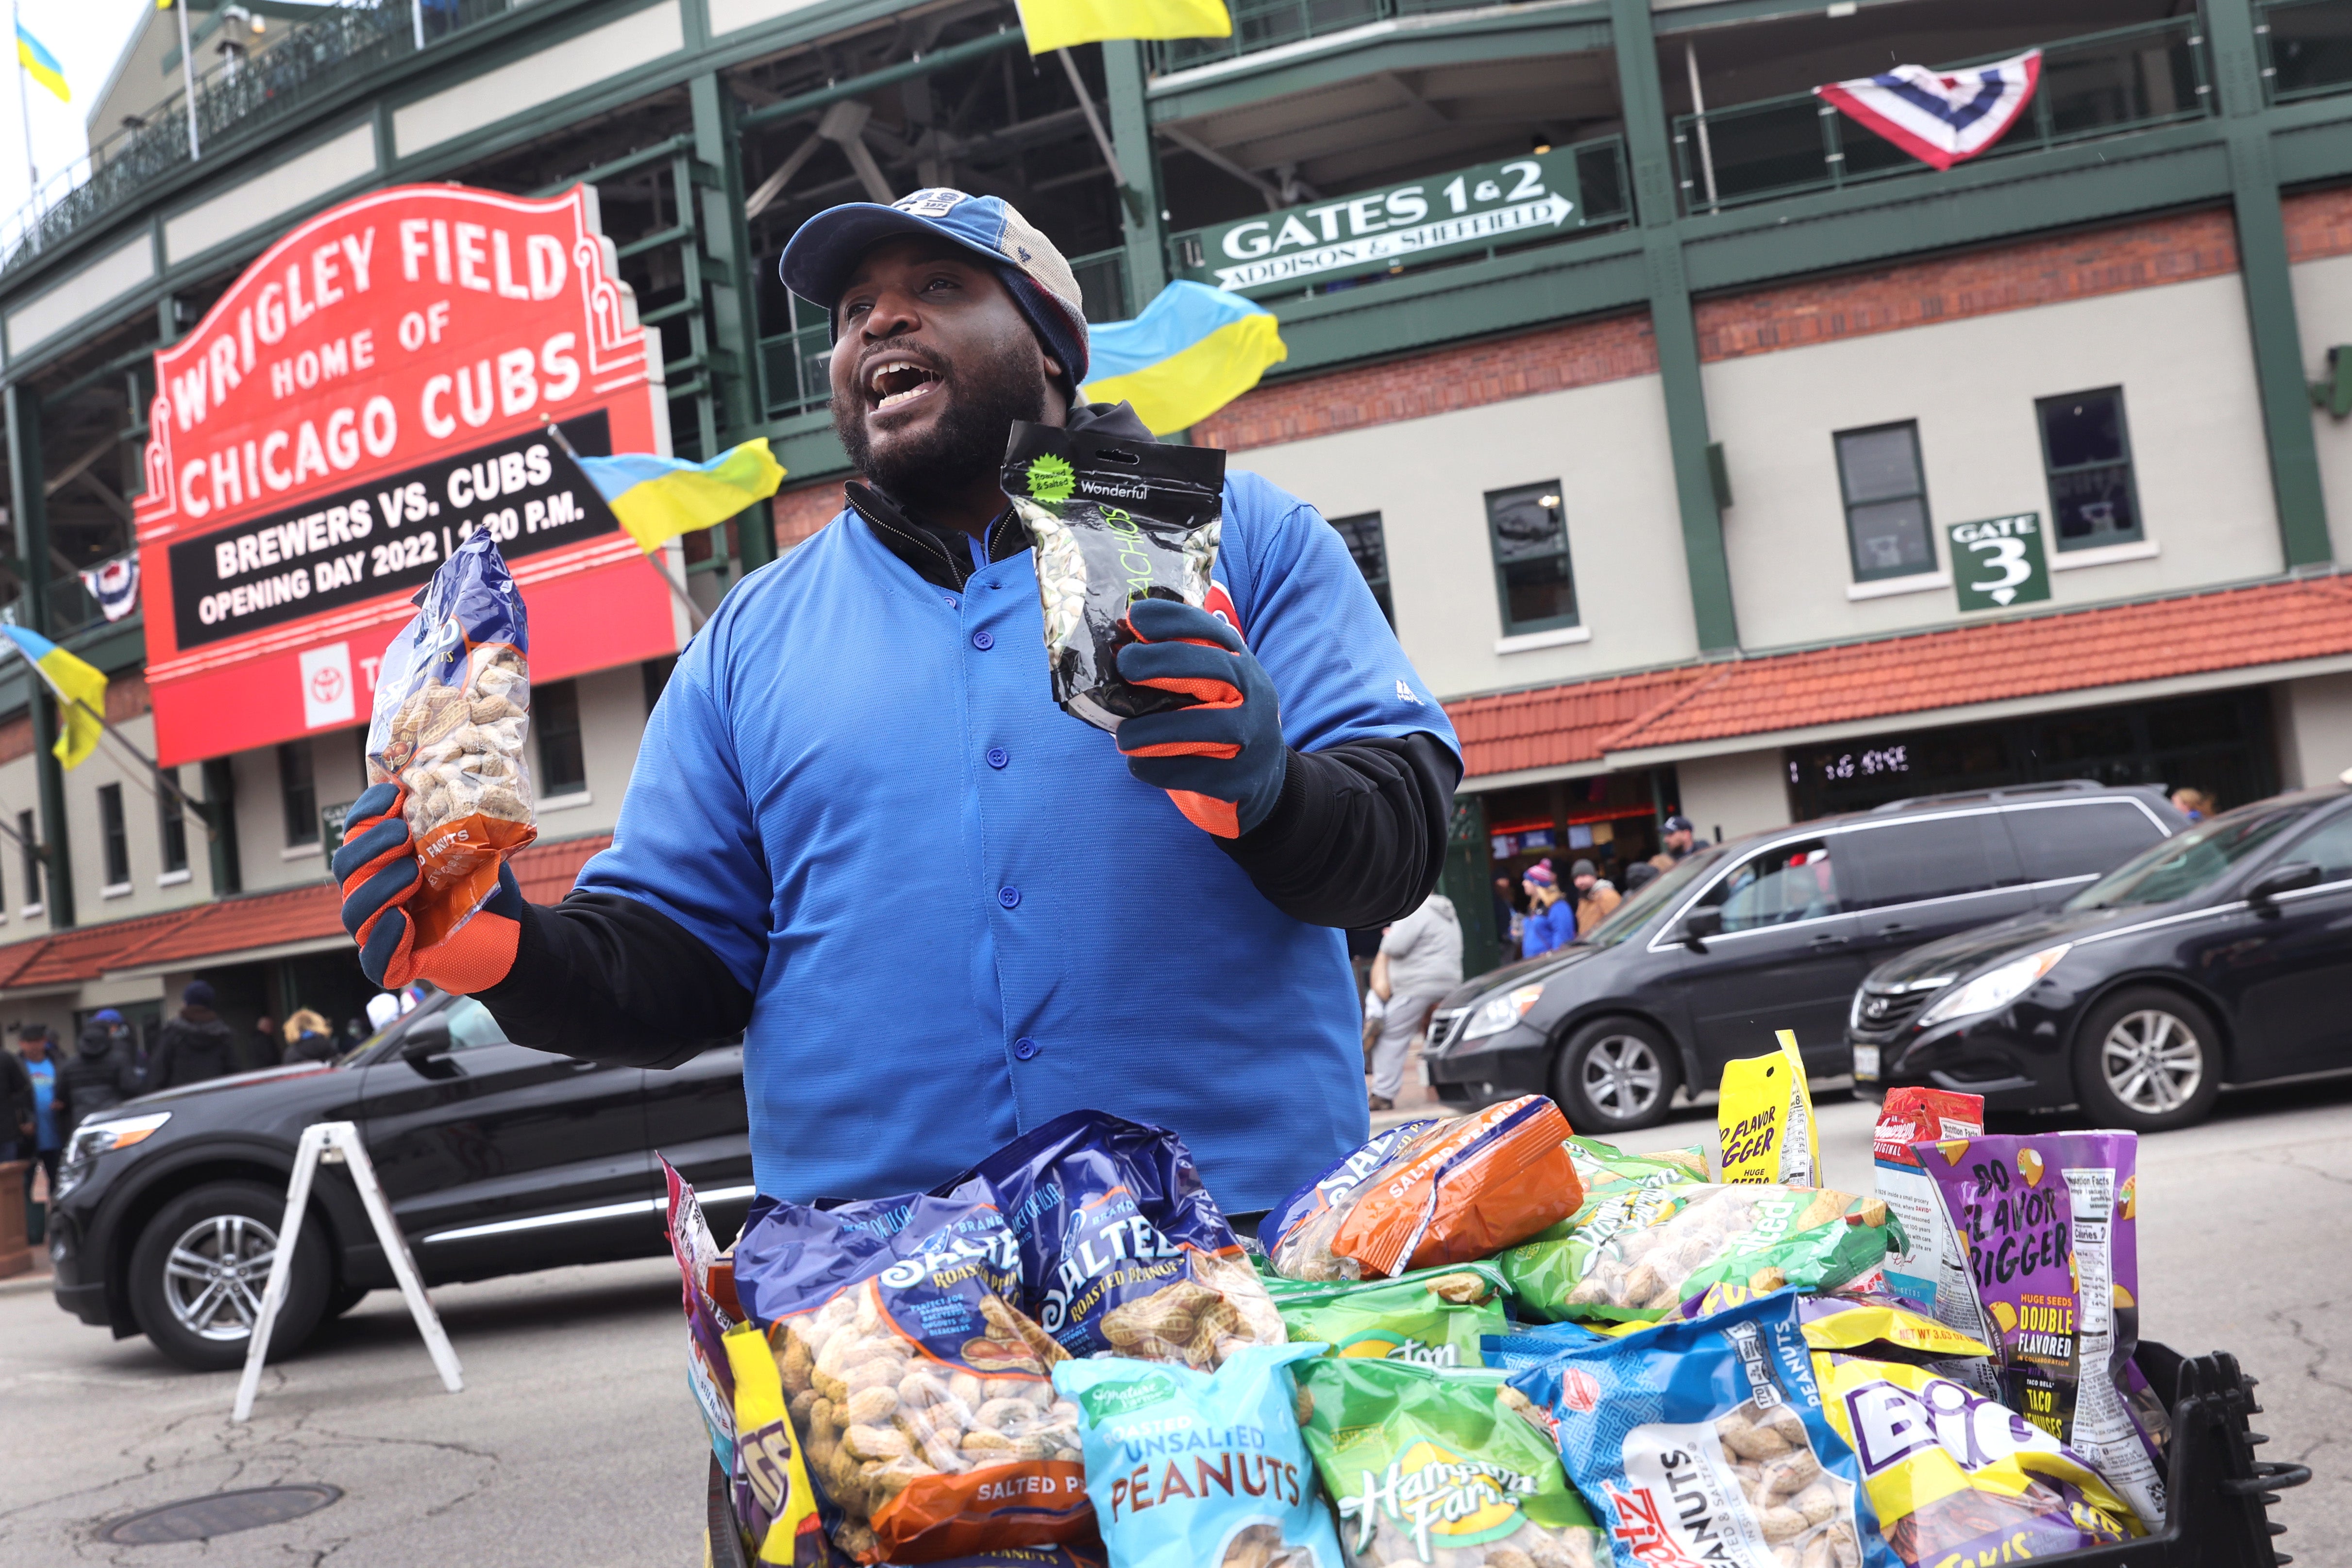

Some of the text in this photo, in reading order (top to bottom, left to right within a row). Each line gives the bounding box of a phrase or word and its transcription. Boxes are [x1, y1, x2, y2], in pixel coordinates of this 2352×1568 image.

[1222, 186, 1429, 260] GATES
[1229, 244, 1358, 289] ADDISON
[1400, 202, 1553, 251] SHEFFIELD
[171, 218, 568, 432] WRIGLEY FIELD
[270, 300, 451, 399] HOME OF
[180, 331, 582, 518] CHICAGO CUBS
[1034, 469, 1066, 482] Roasted
[1036, 478, 1069, 491] & Salted
[1080, 480, 1148, 500] Wonderful
[215, 443, 553, 580] BREWERS VS. CUBS
[1951, 514, 2037, 543] GATE
[198, 570, 312, 625] OPENING
[316, 552, 368, 594] DAY
[371, 530, 438, 579] 2022
[524, 490, 585, 534] P.M.
[1968, 536, 2032, 592] 3
[1730, 1106, 1776, 1143] FLAVOR
[1722, 1127, 1775, 1168] GGER
[1389, 1146, 1455, 1199] SALTED
[1972, 1160, 2010, 1198] DO
[2092, 1176, 2109, 1186] Facts
[1024, 1193, 1042, 1219] OF
[1887, 1190, 1899, 1199] inside
[1914, 1197, 1929, 1205] grocery
[957, 1215, 1005, 1234] BRAND
[1092, 1200, 1135, 1225] BRAND
[1911, 1216, 1931, 1224] seasoned
[1970, 1222, 2069, 1289] BIGGER
[1070, 1270, 1126, 1323] ROASTED
[1900, 1286, 1921, 1298] SEEDS
[2020, 1293, 2072, 1307] HUGE SEEDS
[1899, 1328, 1915, 1341] NET
[1917, 1329, 1932, 1340] WT
[2020, 1306, 2073, 1335] DOUBLE
[2018, 1333, 2072, 1358] FLAVORED
[1774, 1320, 1823, 1408] PEANUTS
[2024, 1355, 2069, 1368] COLLABORATION
[2027, 1367, 2042, 1376] WITH
[2026, 1378, 2038, 1387] TACO
[2026, 1388, 2052, 1413] TACO
[1103, 1416, 1192, 1450] ROASTED
[1125, 1425, 1266, 1465] UNSALTED
[977, 1475, 1057, 1501] SALTED
[1111, 1452, 1300, 1523] PEANUTS
[1695, 1454, 1724, 1507] SALTED
[1337, 1459, 1538, 1556] Hampton
[1719, 1511, 1730, 1523] &
